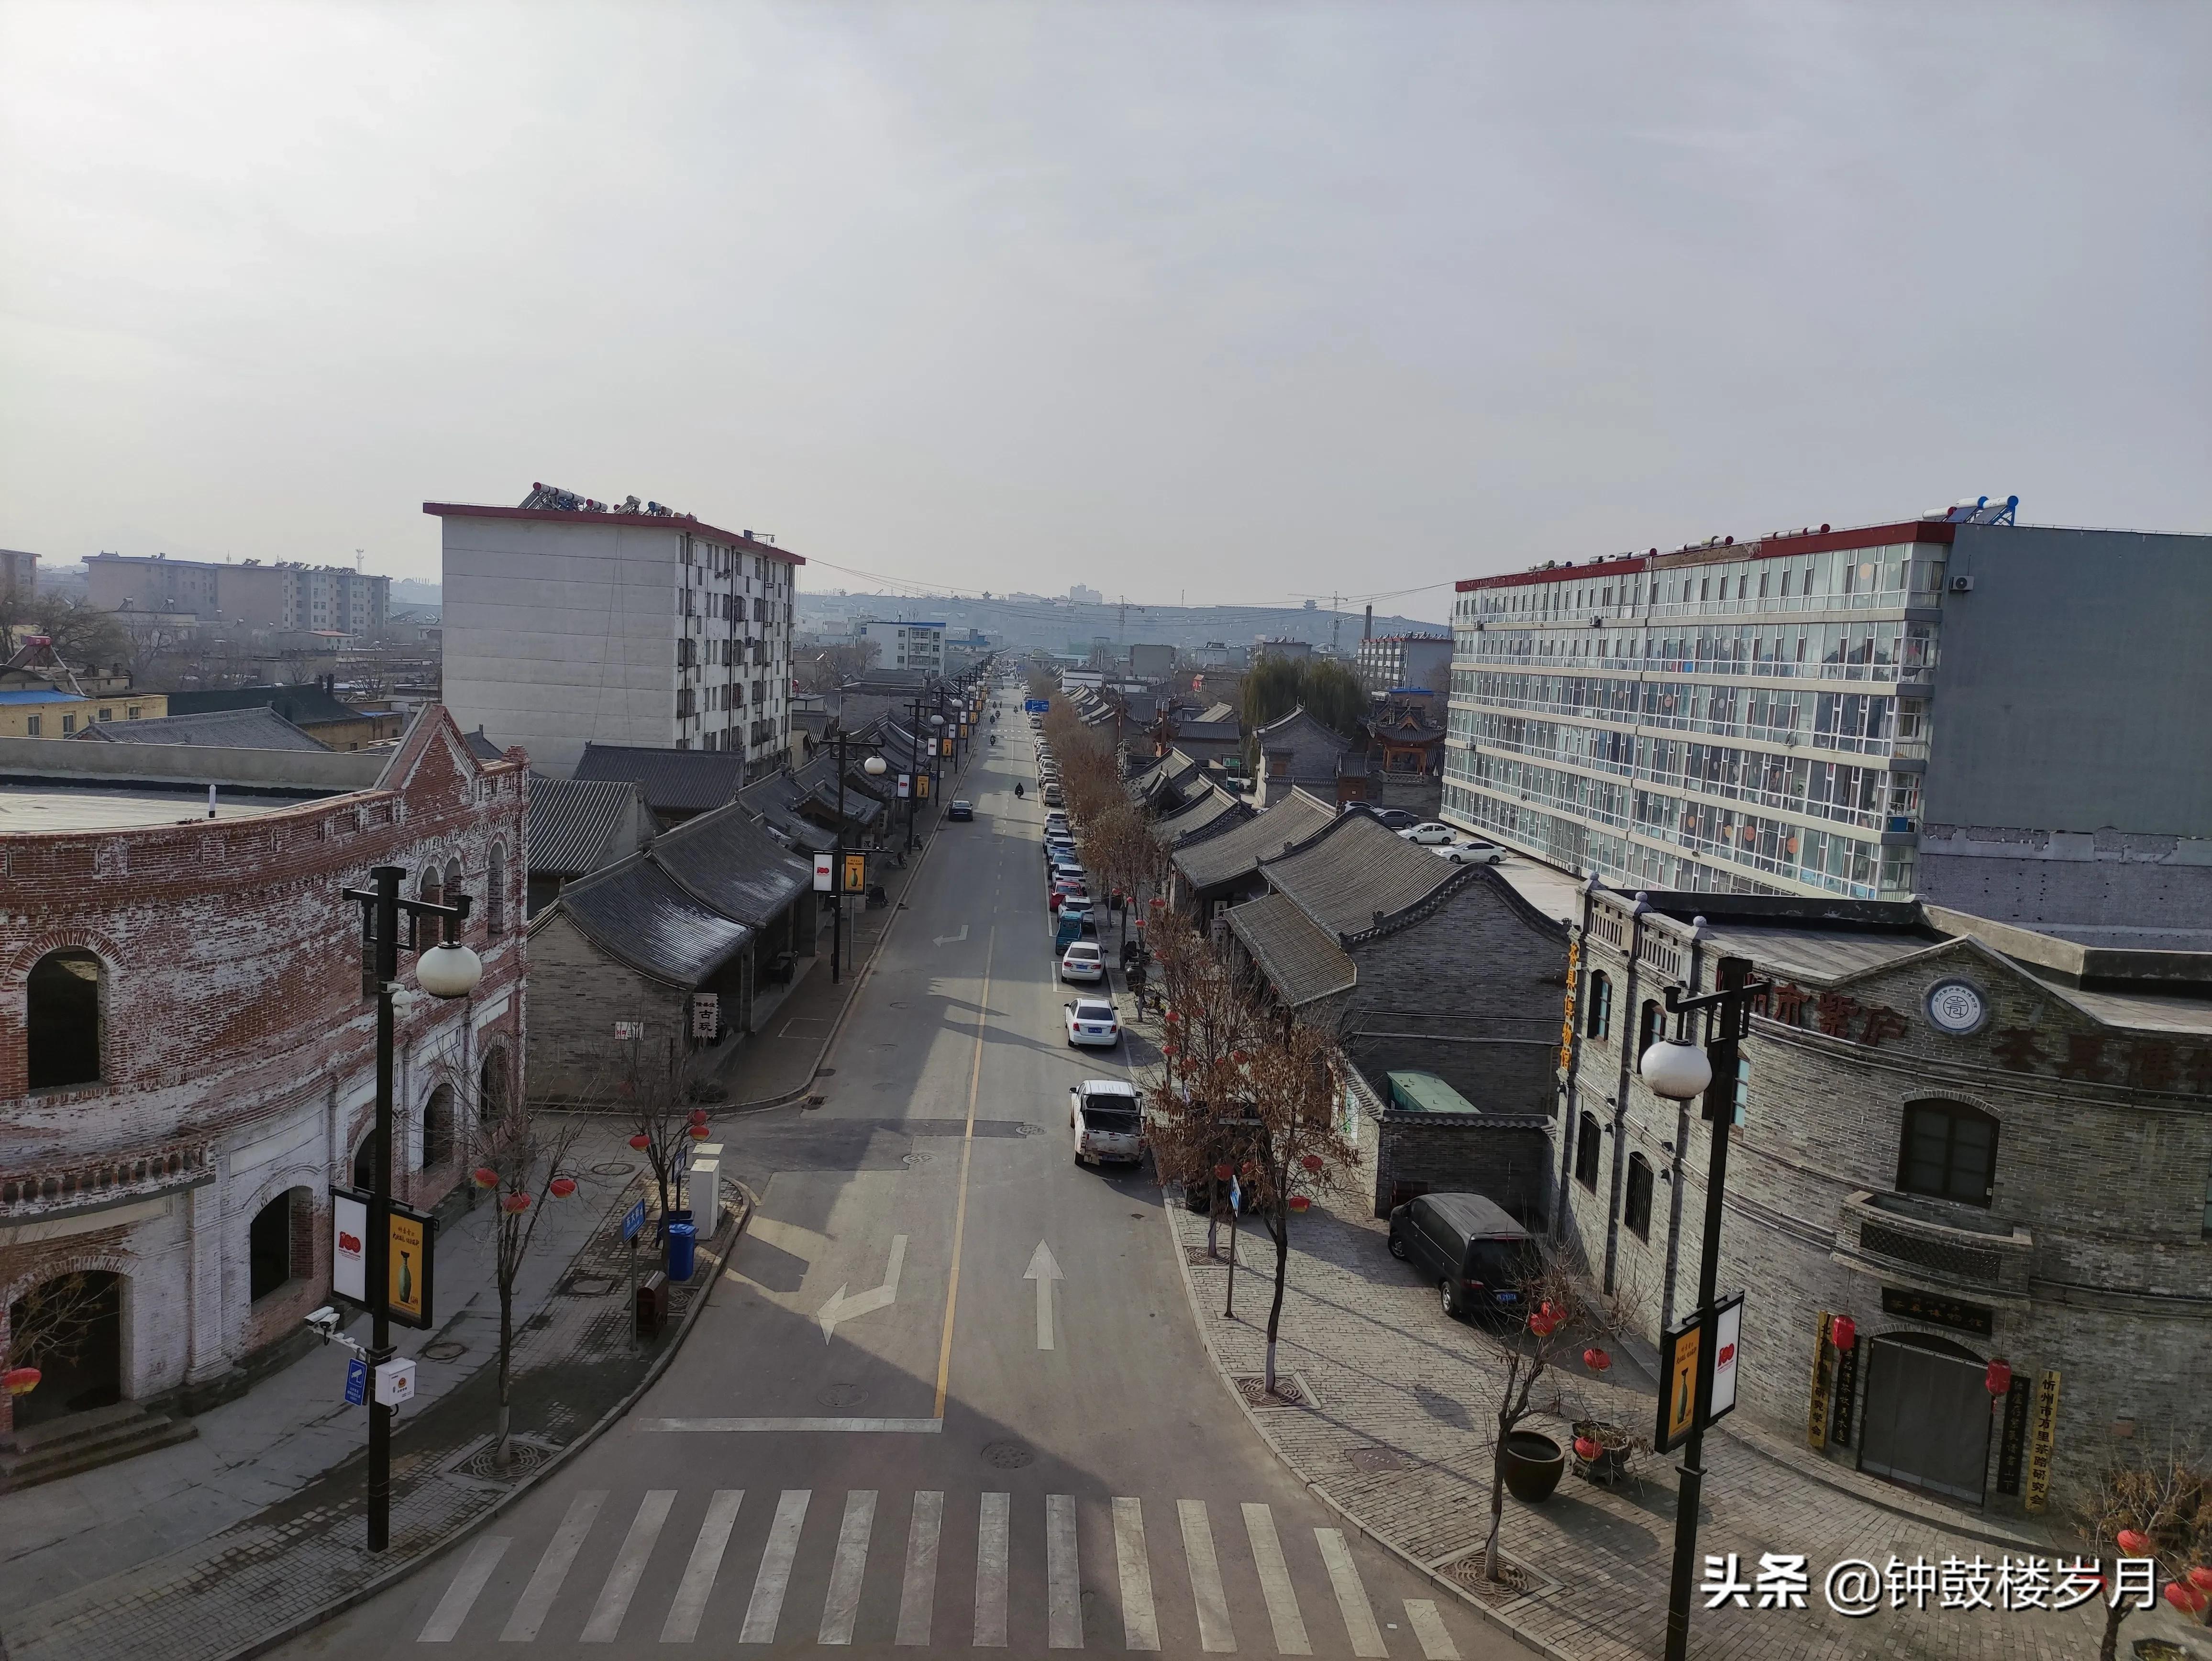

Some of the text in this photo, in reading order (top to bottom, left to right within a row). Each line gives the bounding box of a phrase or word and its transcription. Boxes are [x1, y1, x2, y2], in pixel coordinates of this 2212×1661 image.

[698, 1010, 713, 1031] 古玩
[339, 1231, 361, 1253] 100
[1718, 1343, 1735, 1367] 100
